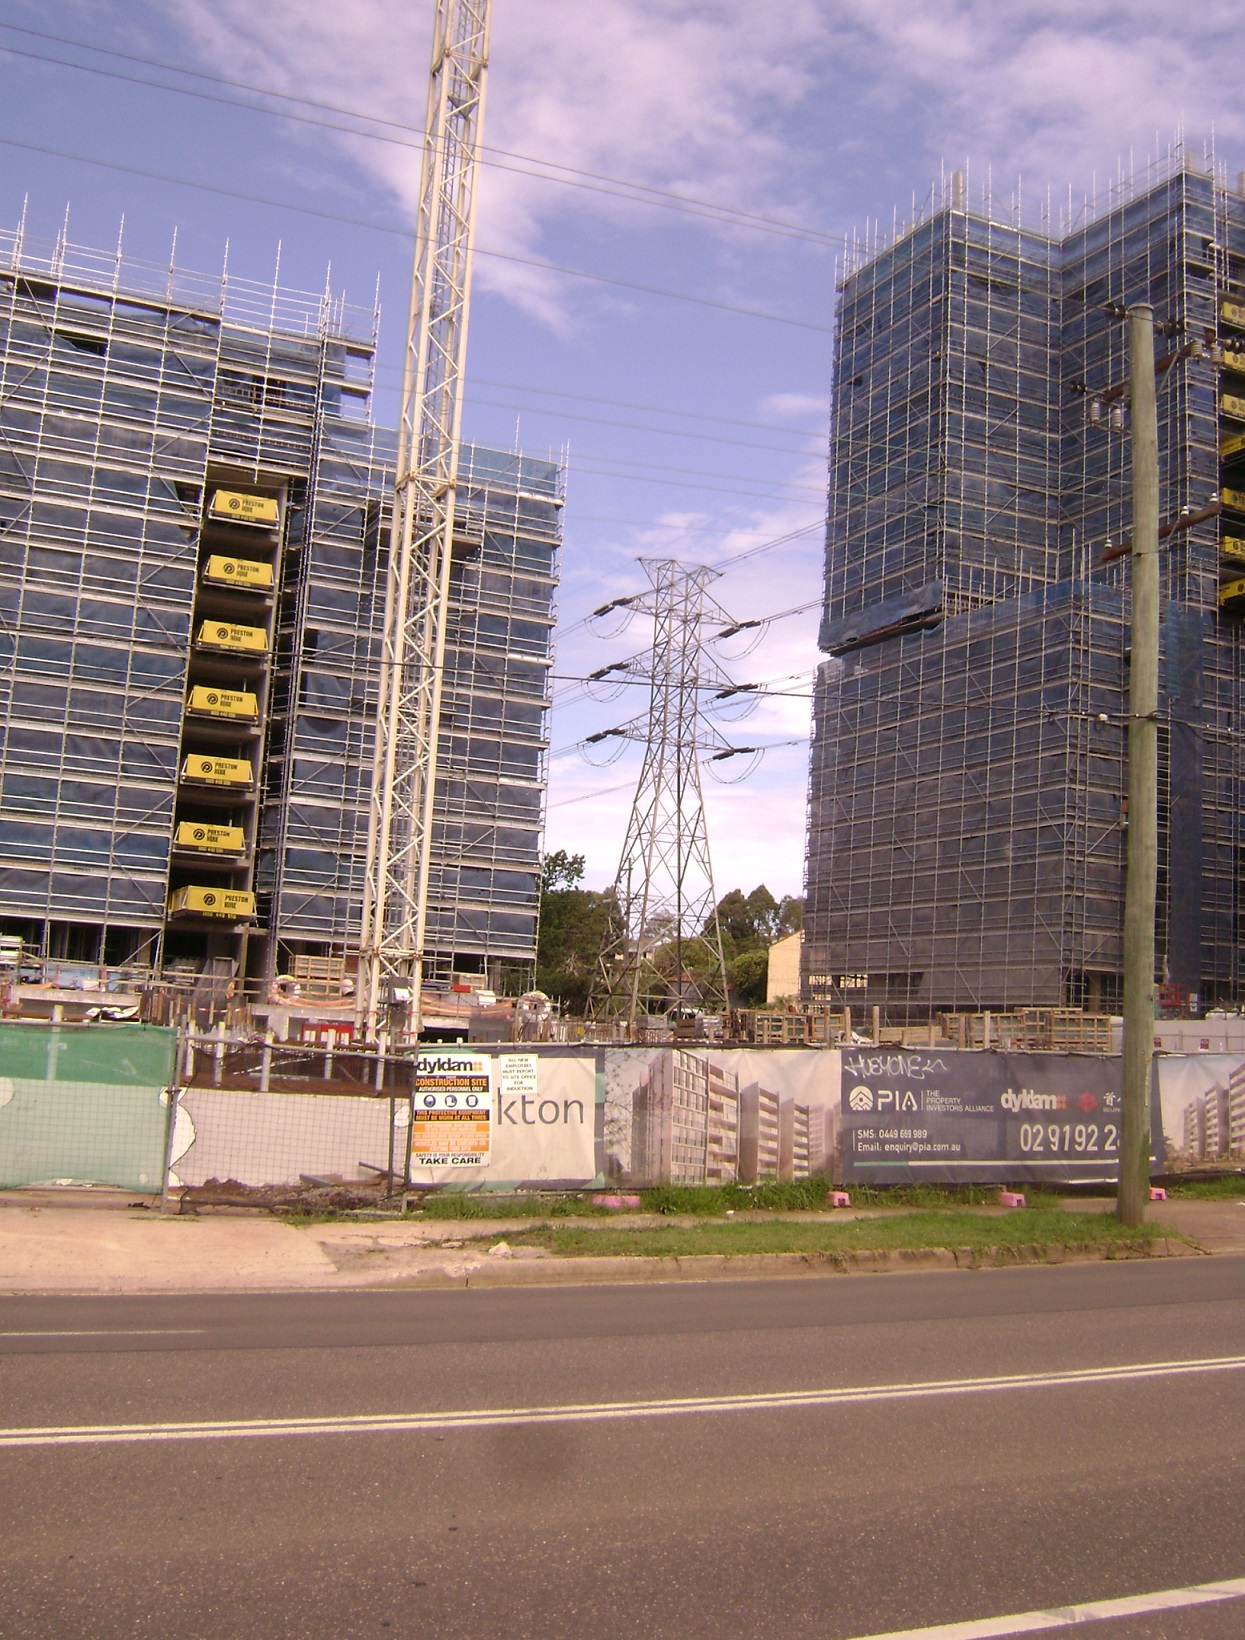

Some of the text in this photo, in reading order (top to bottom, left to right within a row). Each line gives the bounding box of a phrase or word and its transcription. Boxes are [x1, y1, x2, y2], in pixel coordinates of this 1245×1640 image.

[242, 500, 264, 508] PRESTON
[237, 564, 259, 572] PRESTON
[230, 628, 253, 637] PRESTON
[221, 694, 243, 702] PRESTON
[417, 1058, 473, 1074] dyldam
[416, 1078, 470, 1086] CONSTRUCTION
[878, 1090, 917, 1111] PIA
[1001, 1088, 1057, 1112] dyldam
[498, 1087, 583, 1125] kton
[858, 1130, 876, 1138] SMS:
[879, 1130, 898, 1138] 0449
[913, 1130, 927, 1138] 989
[1020, 1124, 1043, 1151] 02
[1048, 1124, 1098, 1151] 9192
[858, 1142, 960, 1153] Email: enquiry@pia.com.au
